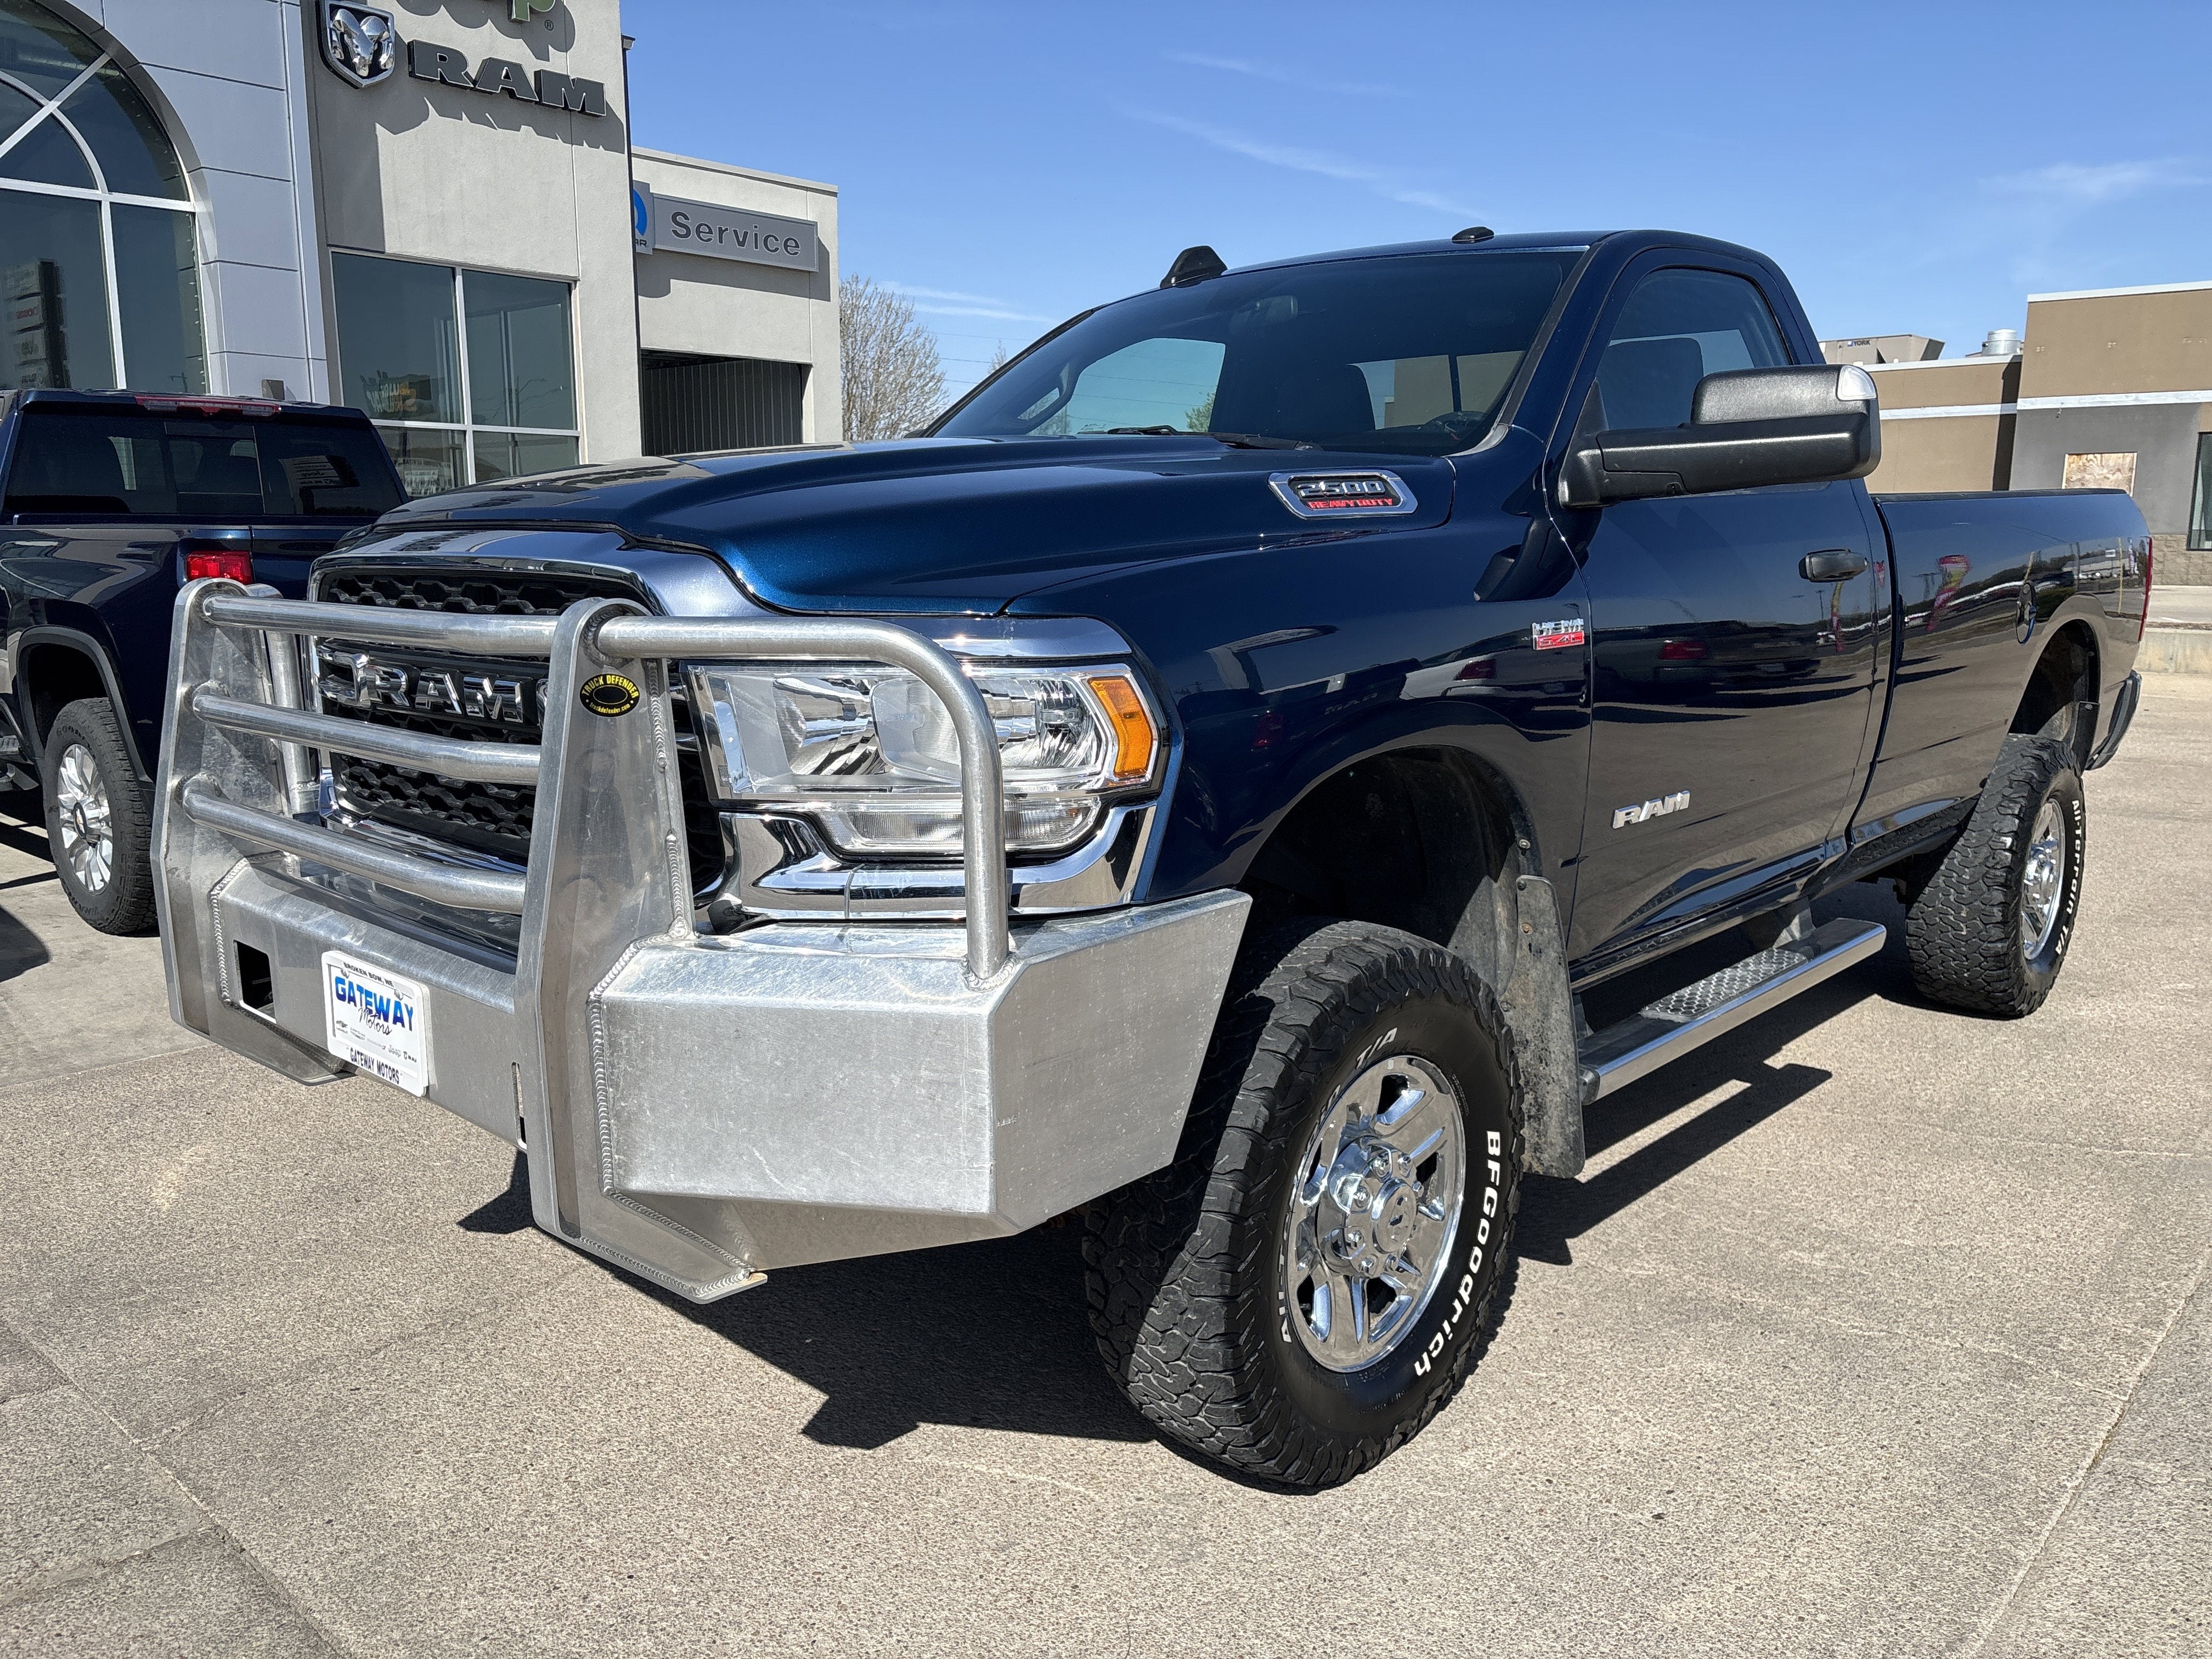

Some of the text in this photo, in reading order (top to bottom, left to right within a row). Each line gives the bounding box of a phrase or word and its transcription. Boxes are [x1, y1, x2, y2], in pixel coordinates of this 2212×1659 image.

[407, 40, 606, 116] RAM
[670, 211, 801, 256] Service
[1296, 481, 1386, 499] 2500
[1308, 498, 1393, 509] HEAVY DUTY
[1532, 618, 1584, 636] HEMI
[364, 664, 524, 723] RAM
[582, 675, 639, 698] TRUCK DEFENDER
[589, 702, 631, 714] truckdefender.com
[1612, 790, 1690, 830] RAM
[2055, 800, 2082, 955] All-Terrain T/A
[343, 962, 368, 977] BROKEN
[335, 976, 414, 1031] GATEWAY
[358, 1006, 393, 1036] Motors
[350, 1046, 400, 1085] GATEWAY MOTORS
[1356, 1027, 1398, 1070] T/A
[1414, 1131, 1502, 1376] BFGoodrich
